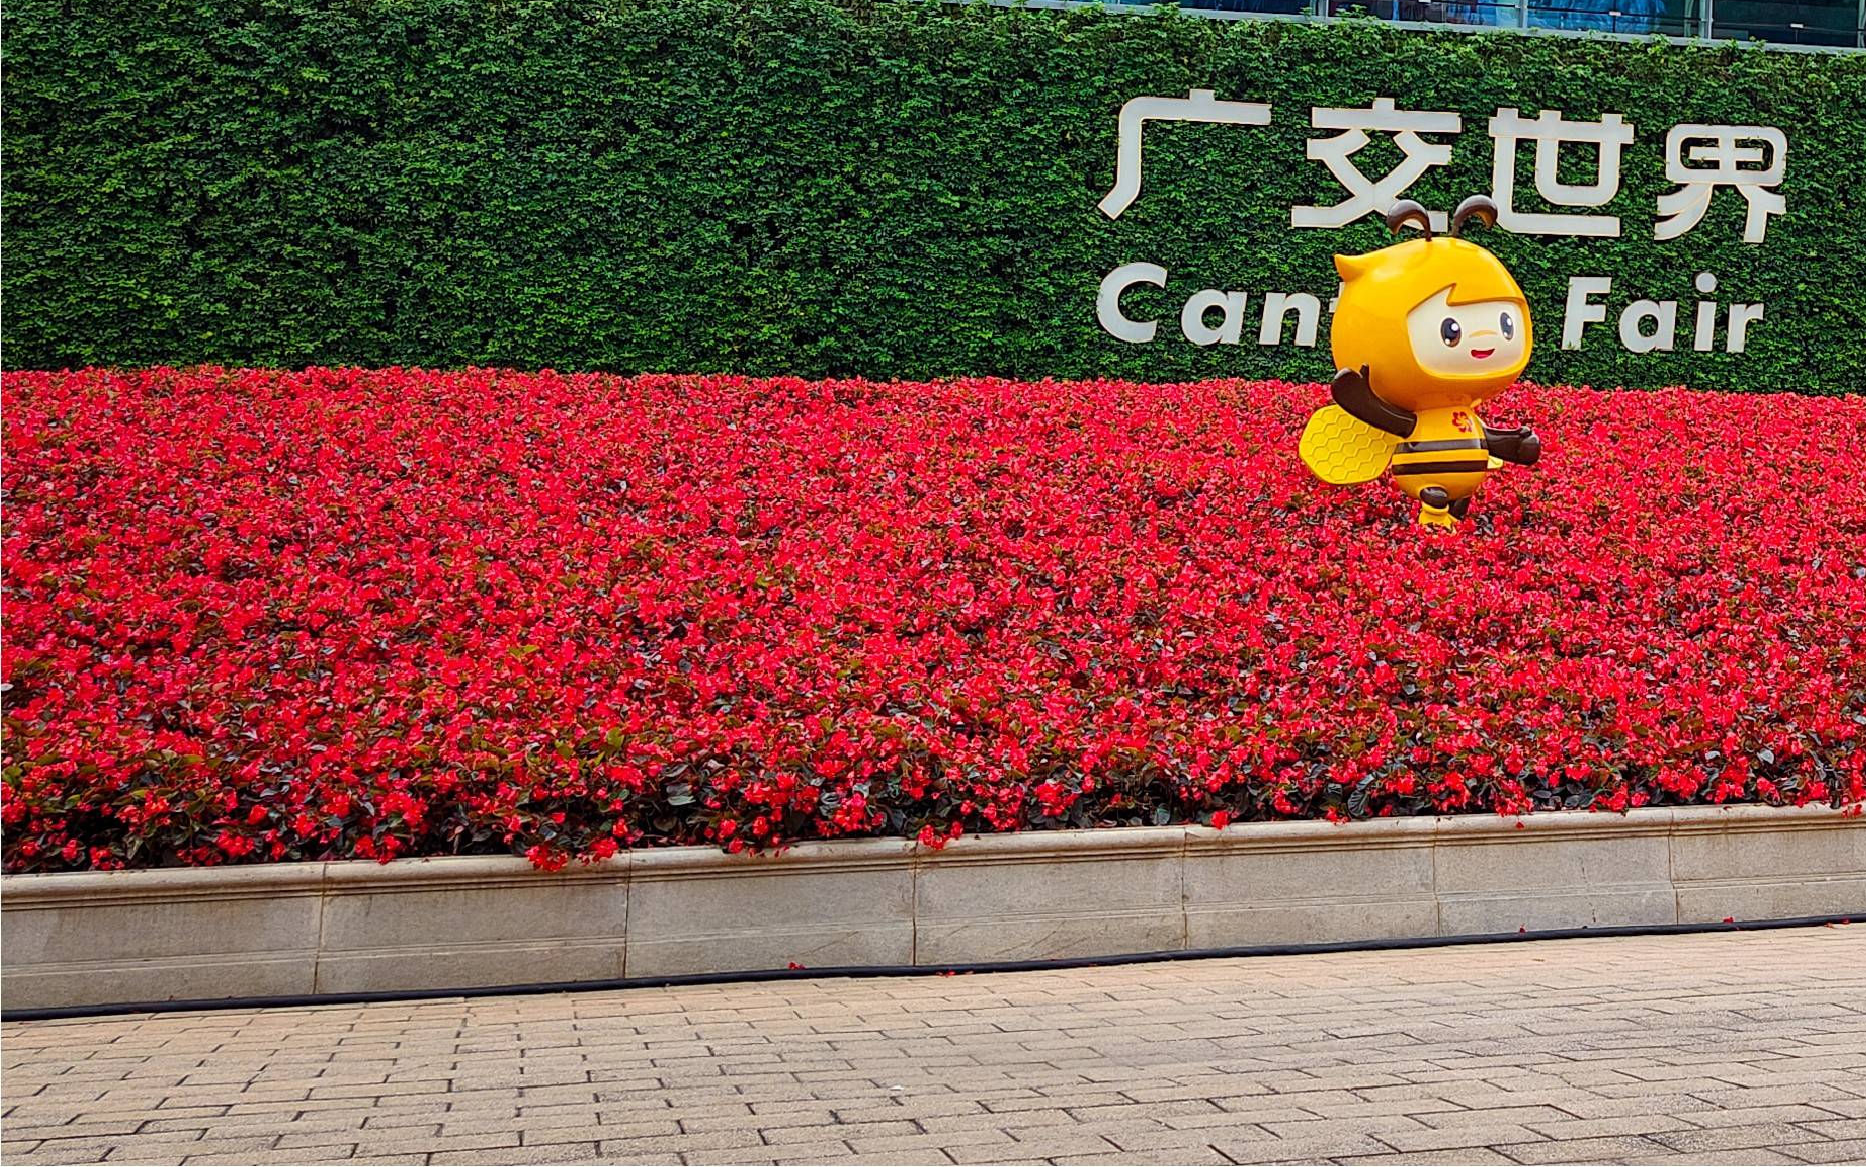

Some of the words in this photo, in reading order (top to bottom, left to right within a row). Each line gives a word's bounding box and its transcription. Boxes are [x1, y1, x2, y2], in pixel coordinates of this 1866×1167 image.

[1097, 88, 1789, 245] 广交世界
[1561, 272, 1766, 354] Fair
